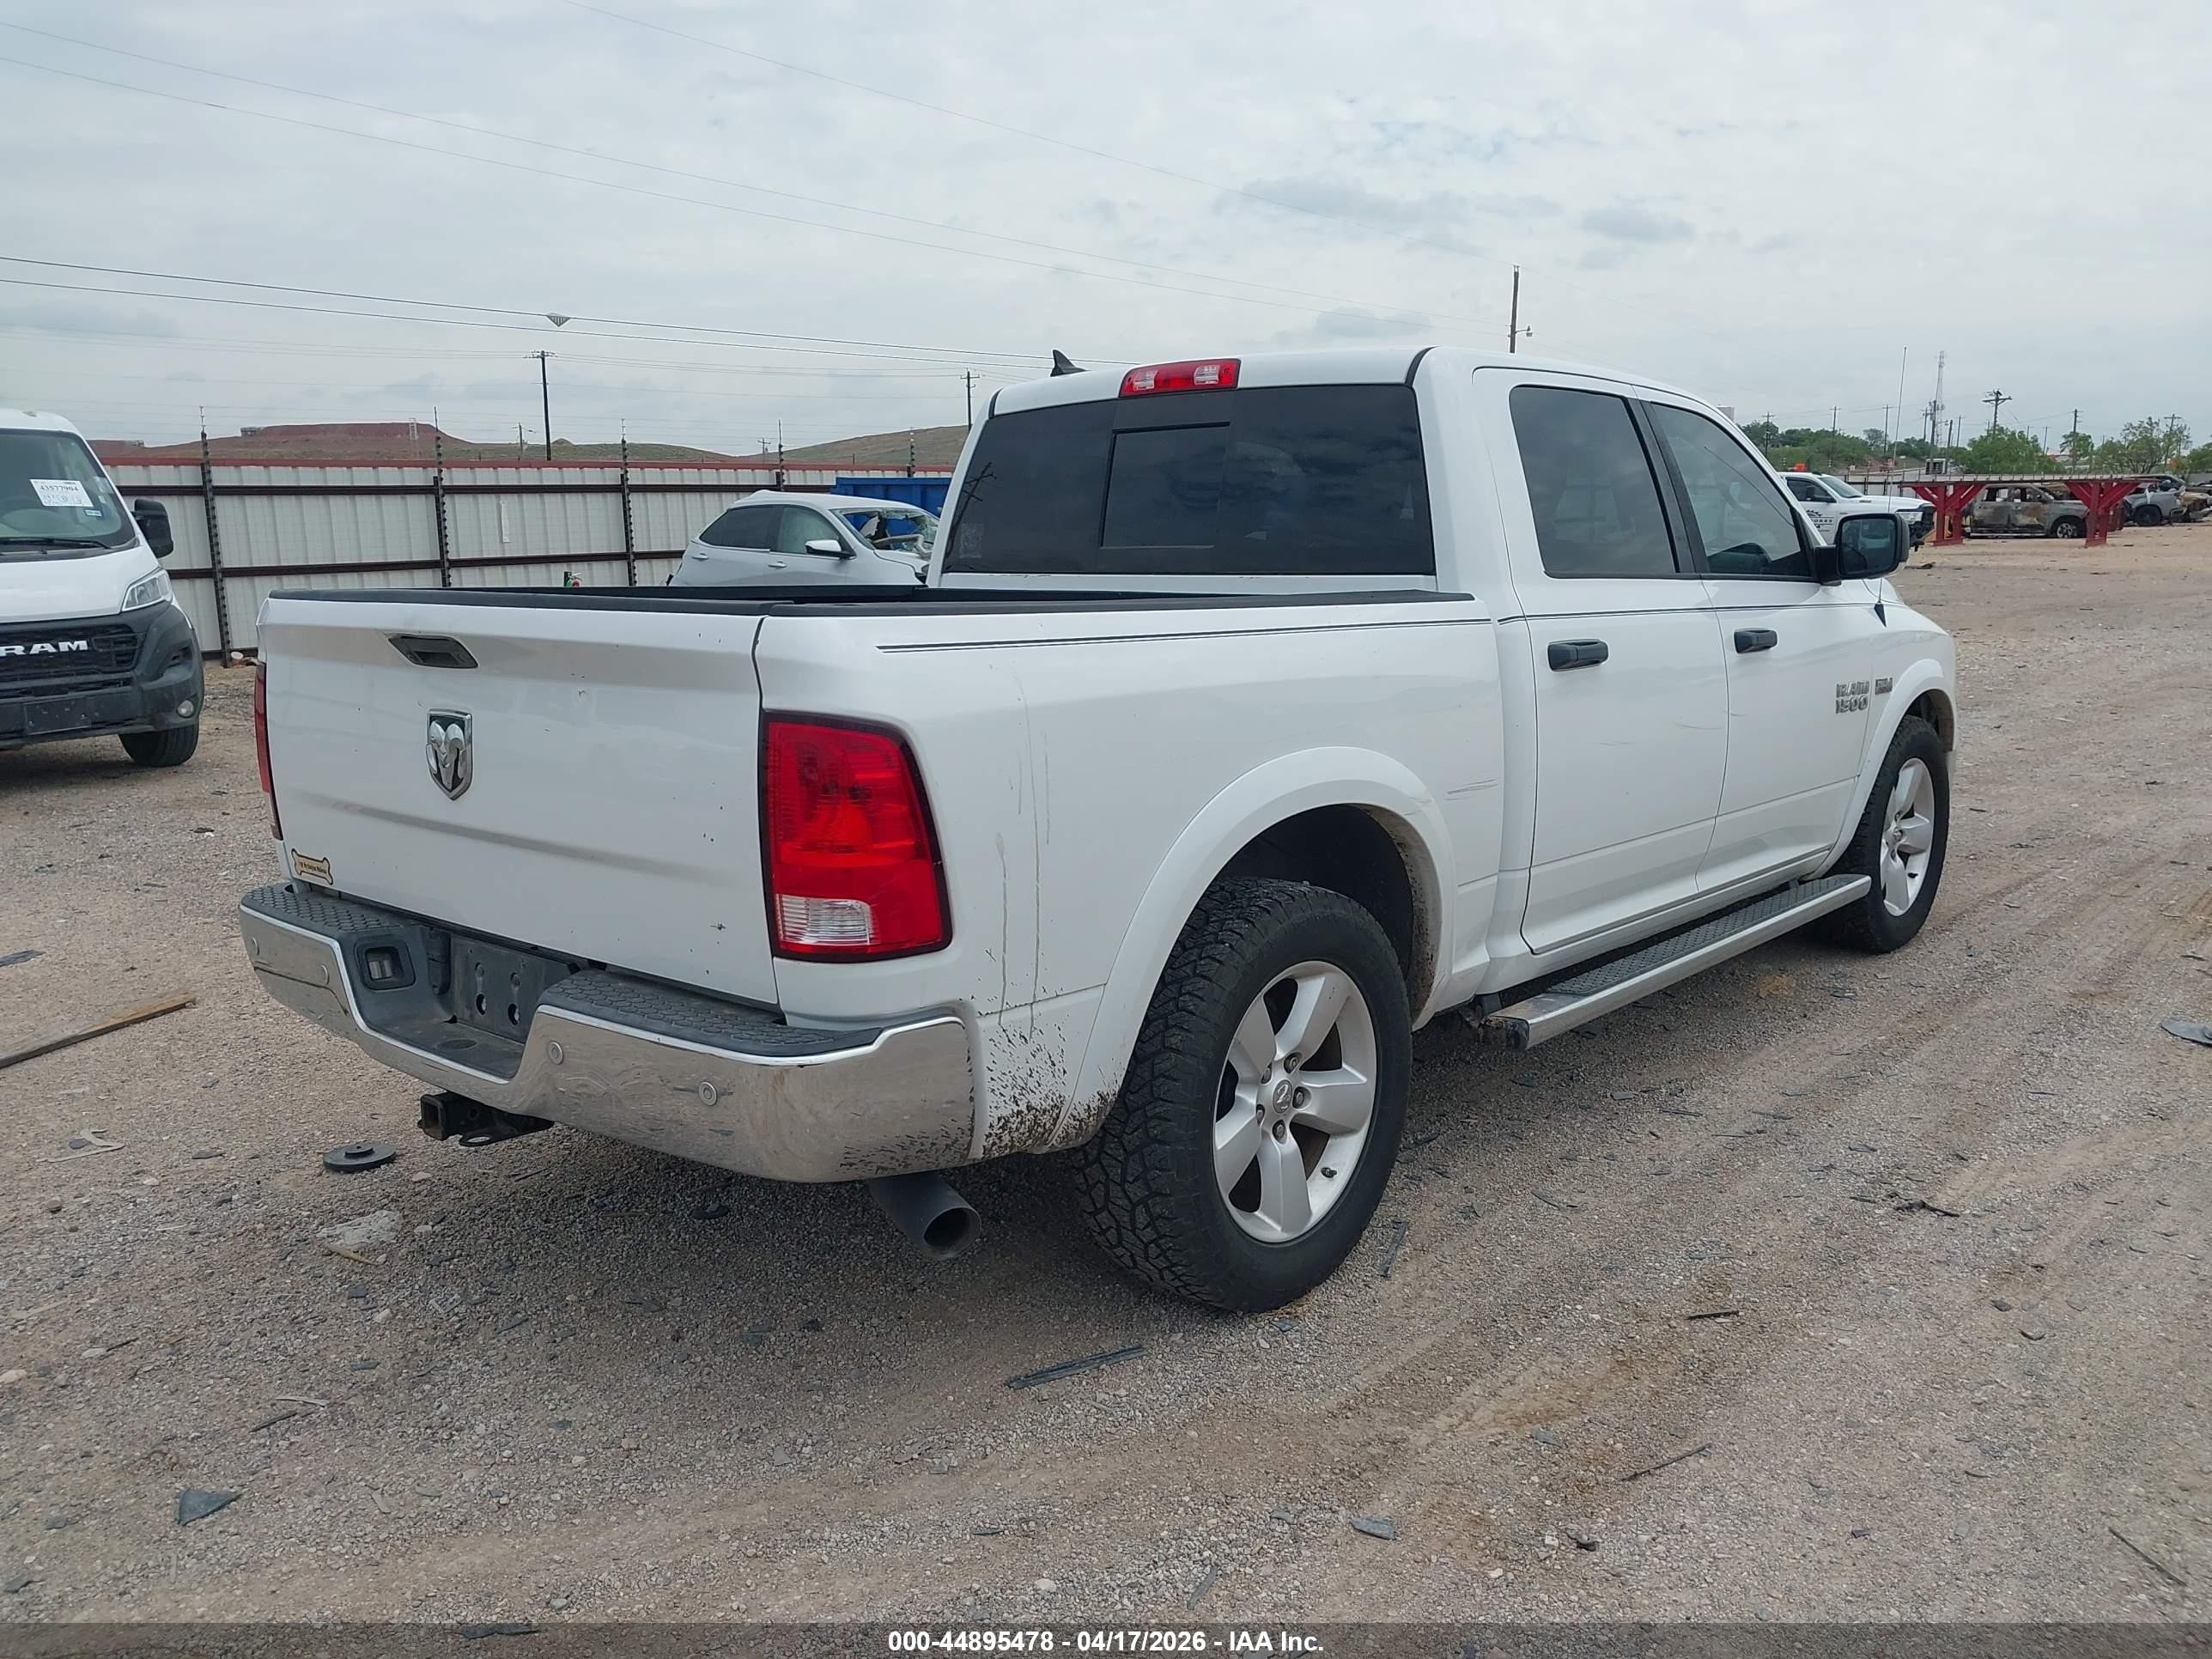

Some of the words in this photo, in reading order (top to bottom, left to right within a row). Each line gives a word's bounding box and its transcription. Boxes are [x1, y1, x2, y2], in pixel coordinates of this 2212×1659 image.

[0, 640, 88, 657] RAM
[1836, 681, 1869, 698] RAM
[1835, 696, 1869, 714] 1500
